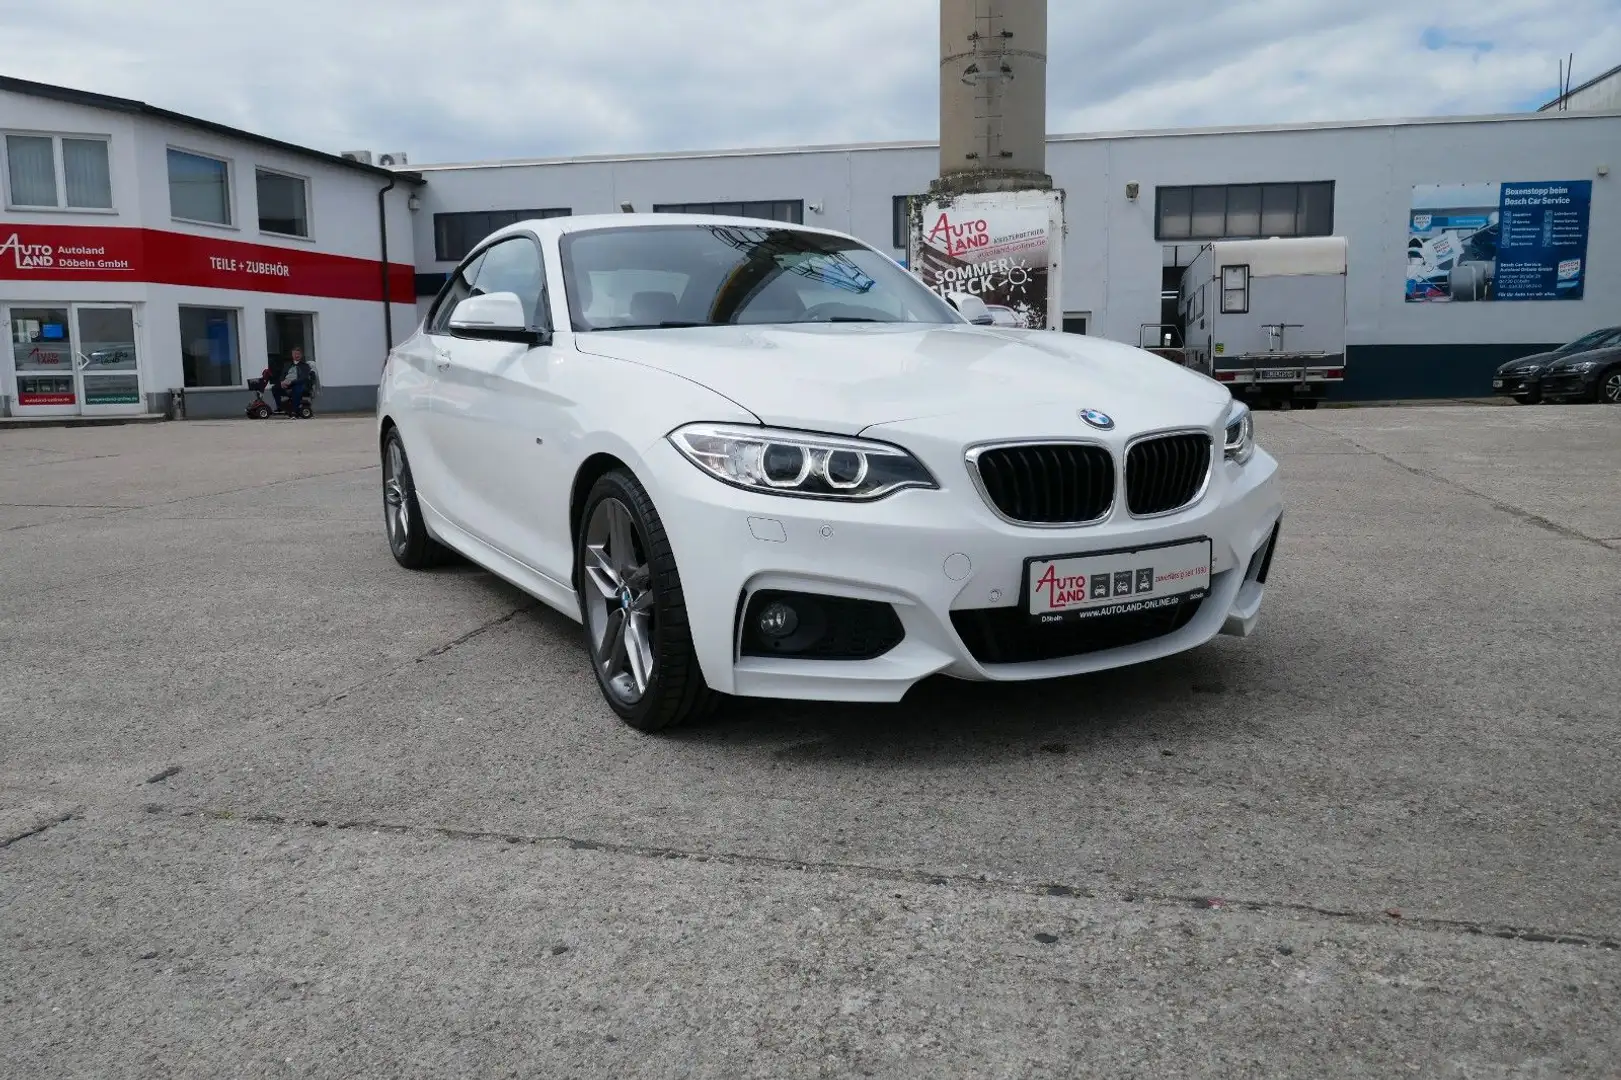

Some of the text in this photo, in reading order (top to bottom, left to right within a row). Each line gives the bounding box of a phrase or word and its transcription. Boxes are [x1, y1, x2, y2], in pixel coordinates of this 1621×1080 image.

[1505, 186, 1568, 196] Boxenstopp beim
[1505, 198, 1527, 206] Bosch
[1542, 197, 1570, 205] Service
[930, 213, 987, 241] AUTO
[0, 233, 53, 256] AUTO
[58, 246, 105, 255] Autoland
[948, 233, 989, 257] LAND
[16, 255, 53, 269] LAND
[59, 259, 128, 268] Döbeln GmbH
[209, 256, 290, 276] TEILE + ZUBEHÖR
[935, 258, 1010, 284] SOMMER
[1036, 565, 1086, 592] AUTO
[1050, 588, 1085, 608] LAND
[1079, 596, 1179, 619] www.AUTOLAND-ONLINE.de
